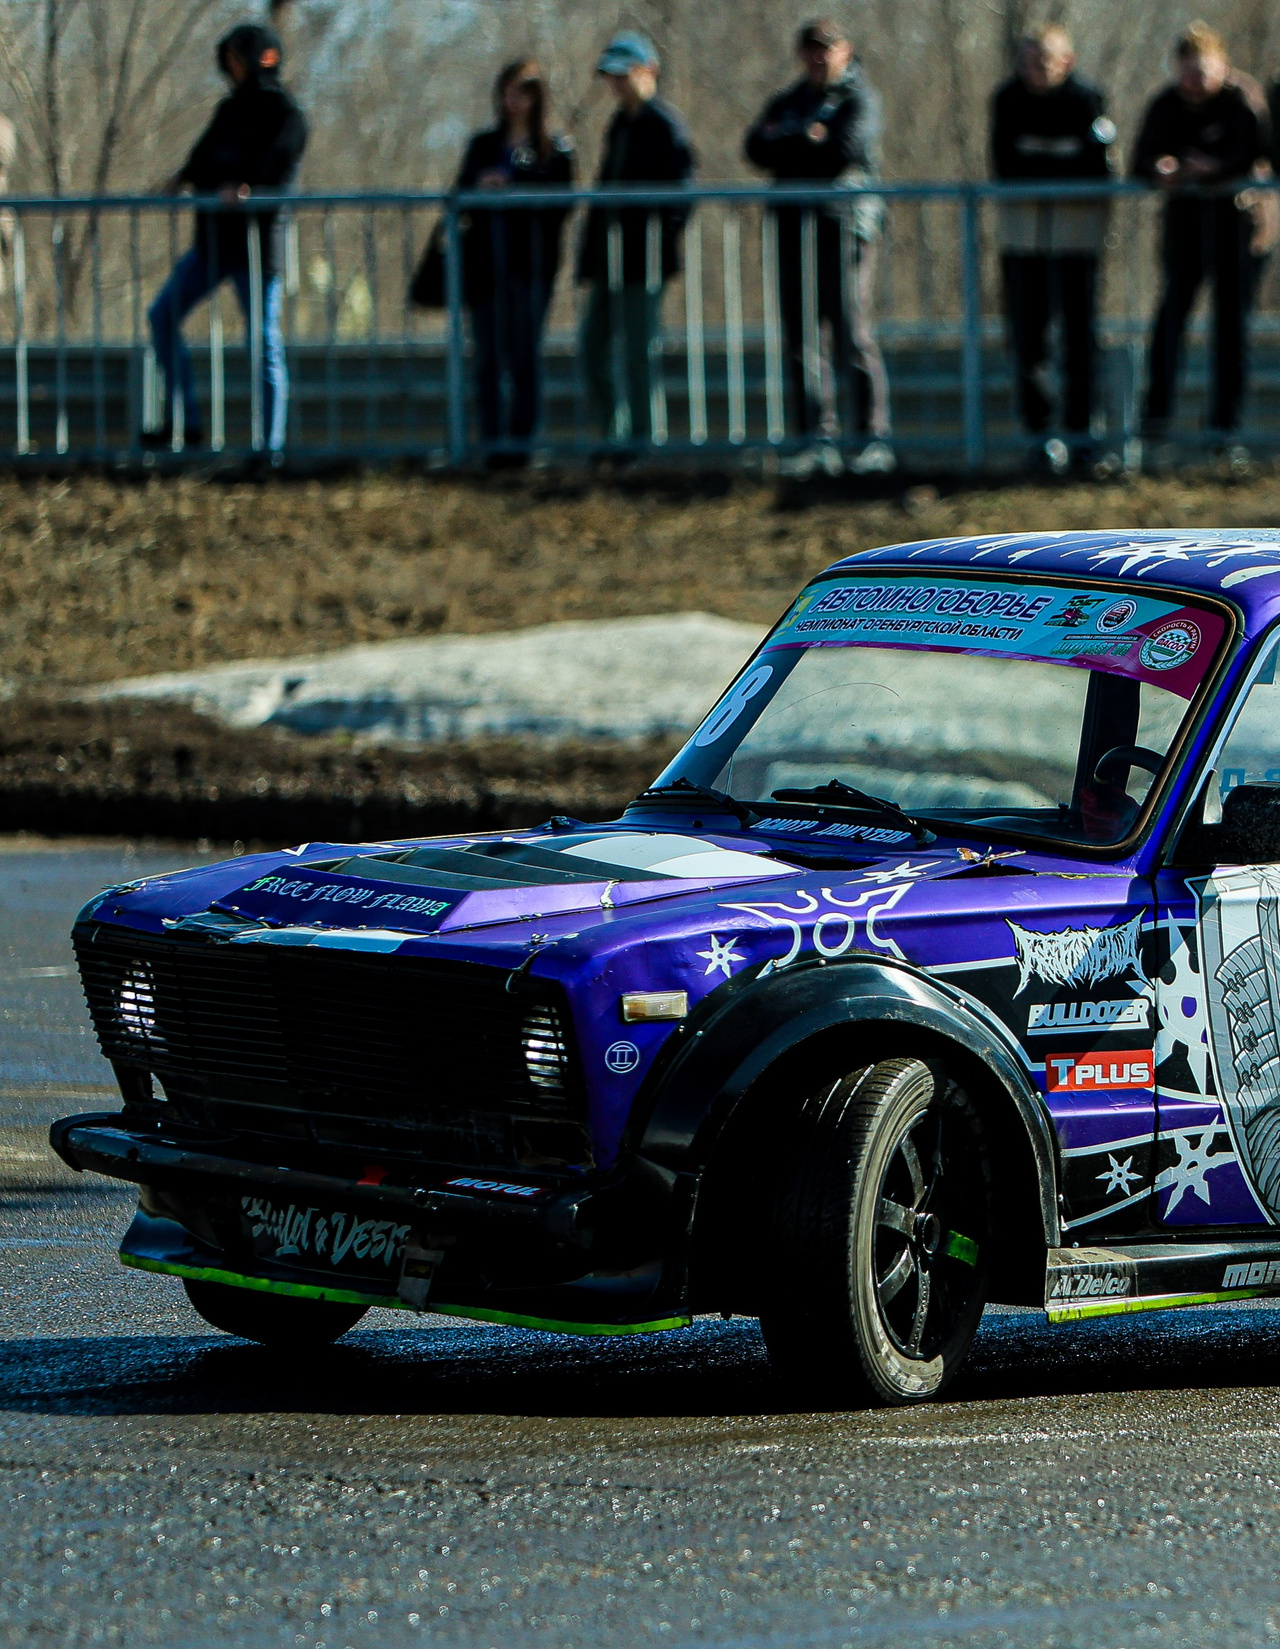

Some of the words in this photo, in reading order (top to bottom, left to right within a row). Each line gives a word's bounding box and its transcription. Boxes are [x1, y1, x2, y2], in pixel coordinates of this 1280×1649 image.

[809, 586, 1054, 621] АВТОМНОГОБОРЬЕ
[796, 618, 865, 632] ЧЕМПИОНАТ
[862, 618, 965, 635] ОРЕНБУРГСКОЙ
[960, 623, 1025, 641] ОБЛАСТИ
[1153, 621, 1188, 638] СКОРОСТЬ
[695, 665, 773, 747] 8
[750, 817, 819, 832] ОСМОТР
[810, 823, 912, 844] ДВИГАТЕЛЯ
[1029, 1000, 1150, 1028] BULLDOZER
[447, 1177, 540, 1196] MOTUL
